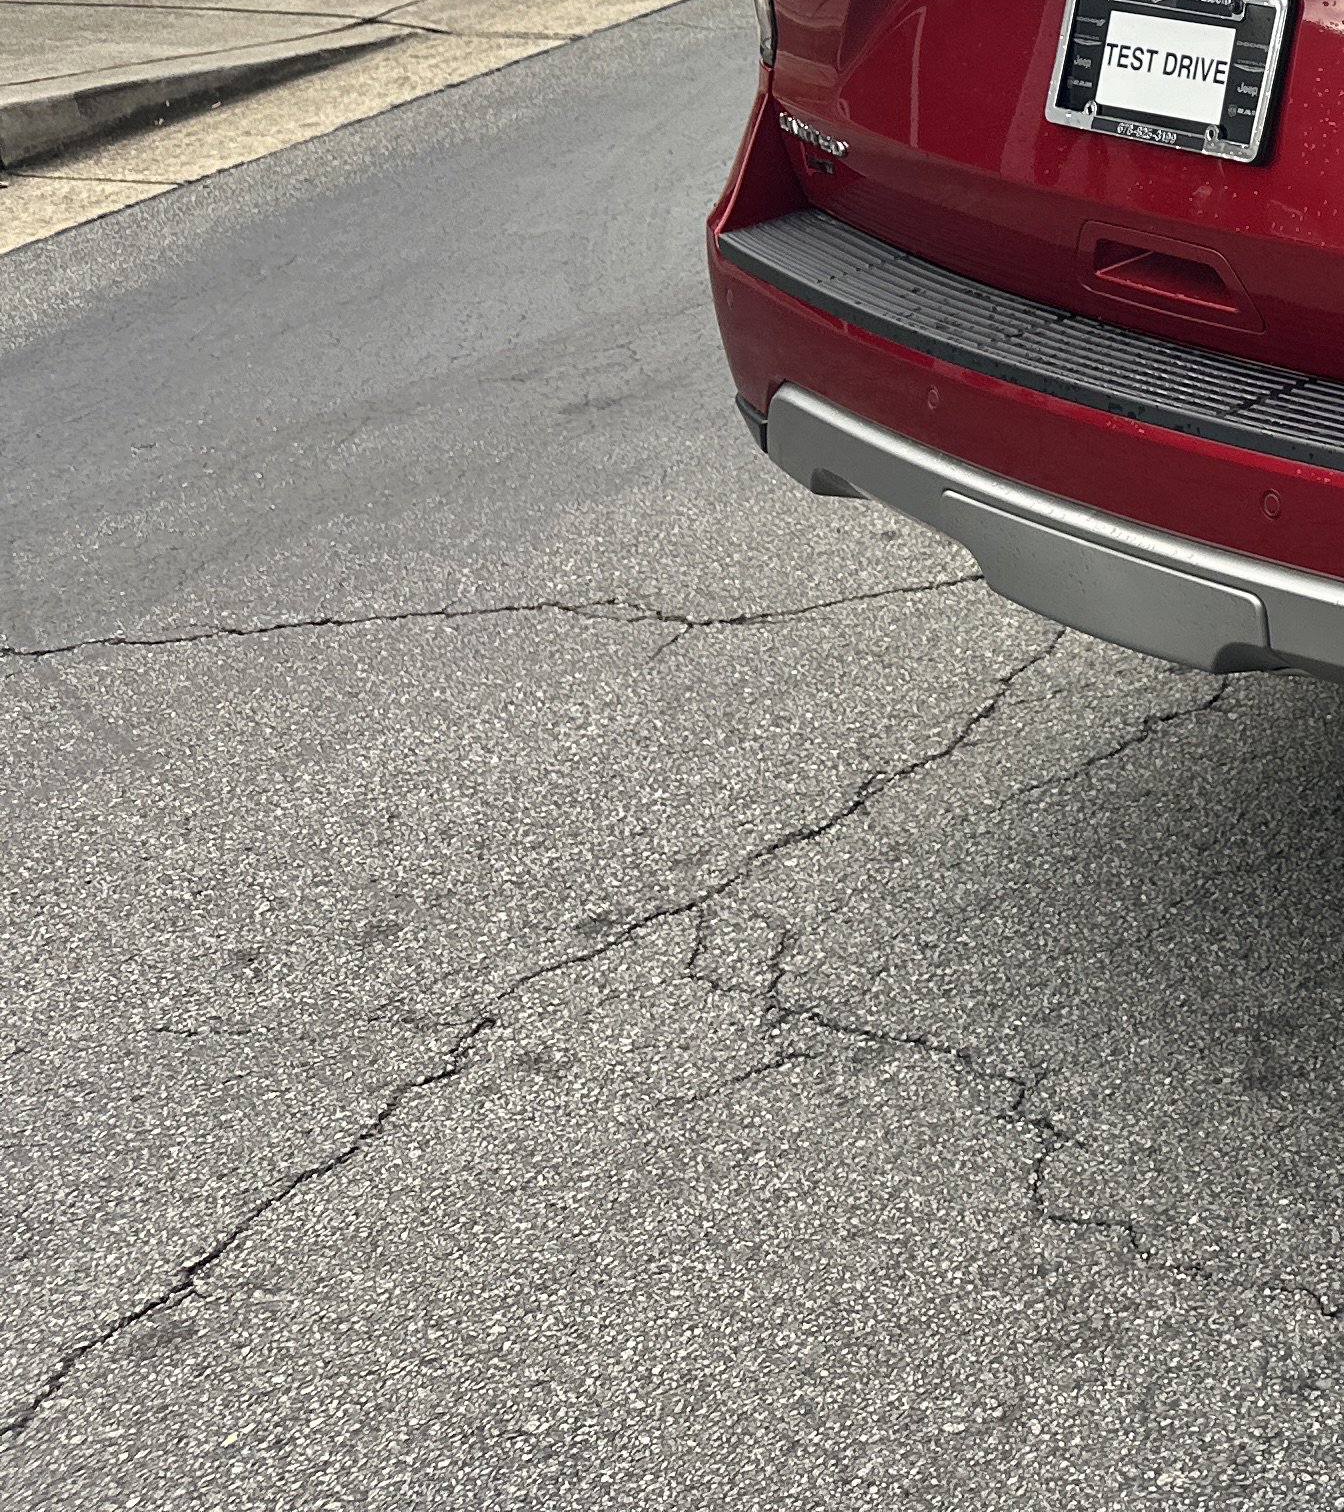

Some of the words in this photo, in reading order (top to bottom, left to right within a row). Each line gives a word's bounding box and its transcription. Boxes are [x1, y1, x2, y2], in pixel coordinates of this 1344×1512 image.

[1106, 42, 1158, 73] TEST
[1163, 51, 1229, 85] DRIVE
[1237, 82, 1259, 97] Jeep
